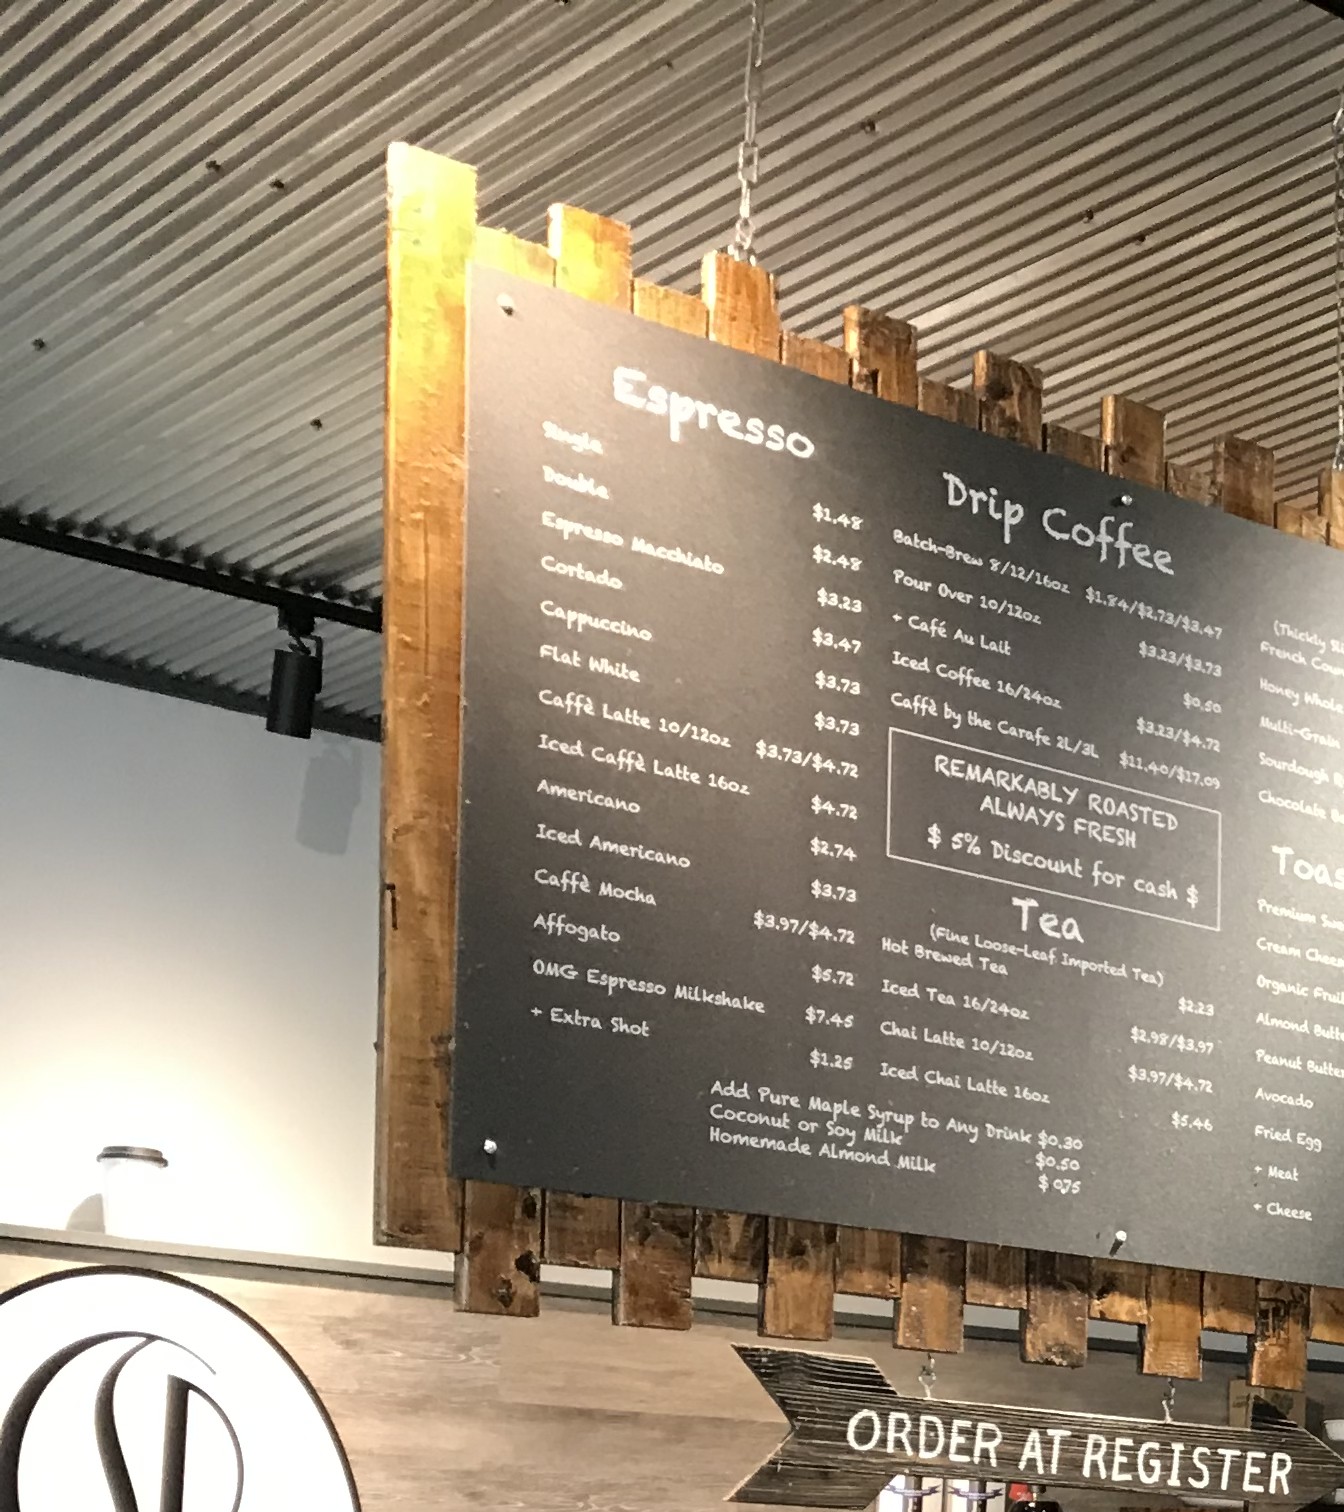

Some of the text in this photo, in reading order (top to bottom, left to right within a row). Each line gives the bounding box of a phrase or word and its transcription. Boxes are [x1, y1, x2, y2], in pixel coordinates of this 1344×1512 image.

[612, 366, 816, 459] Espresso
[542, 465, 863, 572] Double $2.48
[812, 502, 864, 531] $1.48
[942, 471, 1175, 576] Drip Coffee
[541, 510, 863, 614] Espresso Macchiato $3.23
[540, 555, 862, 655] Cortado $3.47
[539, 599, 861, 696] Cappuccino $3.73
[952, 628, 976, 646] Au
[539, 644, 861, 736] Flat White $3.73
[891, 650, 992, 691] Iced Coffee
[602, 702, 652, 730] Latte
[658, 717, 732, 748] 10/12oz
[943, 701, 963, 730] by
[967, 709, 993, 731] the
[996, 720, 1052, 747] Carafe
[537, 733, 585, 758] Iced
[653, 758, 702, 785] Latte
[707, 772, 751, 796] 16oz
[810, 793, 858, 821] $4.72
[934, 753, 1179, 831] REMARKABLY ROASTED
[536, 778, 858, 862] Americano $2.74
[979, 794, 1137, 849] ALWAYS FRESH
[535, 823, 857, 903] Iced Americano $3.73
[950, 831, 982, 856] 5%
[990, 839, 1083, 879] Discount
[1091, 860, 1126, 889] for
[1133, 878, 1178, 900] cash
[598, 881, 657, 907] Mocha
[533, 912, 621, 943] Affogato
[1011, 896, 1085, 944] Tea
[1256, 937, 1301, 958] Cream
[532, 958, 580, 980] OMG
[586, 968, 667, 997] Espresso
[673, 983, 766, 1014] Milkshake
[881, 978, 957, 1007] Iced Tea
[1256, 974, 1309, 997] Organic
[550, 1006, 603, 1030] Extra
[610, 1016, 650, 1038] Shot
[879, 1020, 918, 1041] Chai
[923, 1027, 966, 1050] Latte
[1255, 1012, 1310, 1034] Almond
[1255, 1048, 1303, 1071] Peanut
[710, 1079, 752, 1101] Add
[757, 1086, 802, 1109] Pure
[809, 1096, 860, 1120] Maple
[868, 1106, 914, 1130] Syrup
[920, 1110, 941, 1129] to
[945, 1117, 979, 1144] Any
[984, 1122, 1033, 1144] Drink
[1254, 1087, 1314, 1110] Avocado
[709, 1125, 937, 1174] Homemade Almond Milk
[1254, 1124, 1323, 1153] Fried Egg
[1267, 1165, 1299, 1182] Meat
[1266, 1201, 1313, 1222] Cheese
[847, 1408, 1292, 1494] ORDER AT REGISTER
